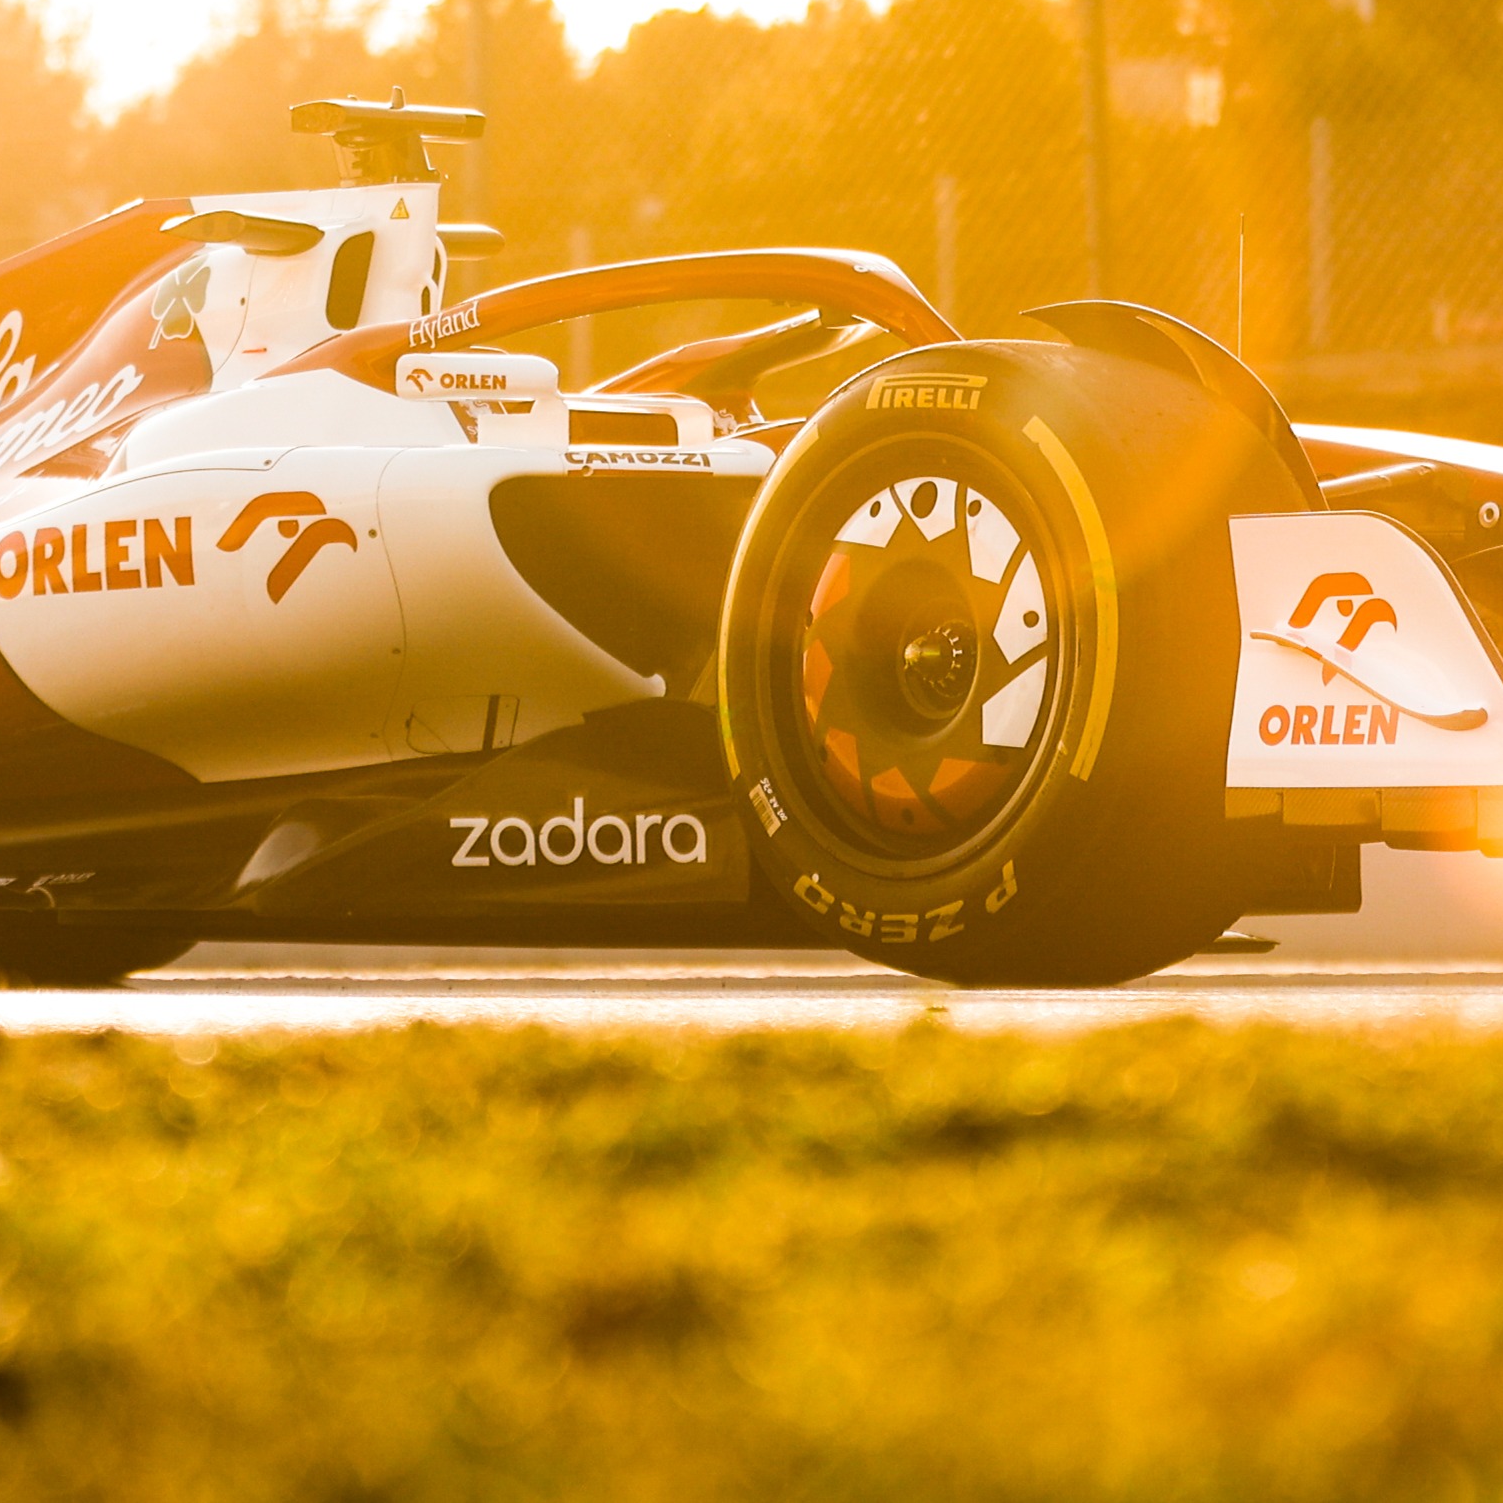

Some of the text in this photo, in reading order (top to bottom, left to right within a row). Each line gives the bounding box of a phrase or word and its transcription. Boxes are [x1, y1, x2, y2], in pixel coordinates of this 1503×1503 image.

[409, 300, 481, 349] Hyland
[439, 372, 507, 390] ORLEN
[865, 373, 988, 410] PIRELLI
[564, 452, 712, 468] CAMOZZI
[1258, 704, 1399, 747] ORLEN
[449, 796, 707, 867] zadara
[793, 859, 1018, 944] P ZERO
